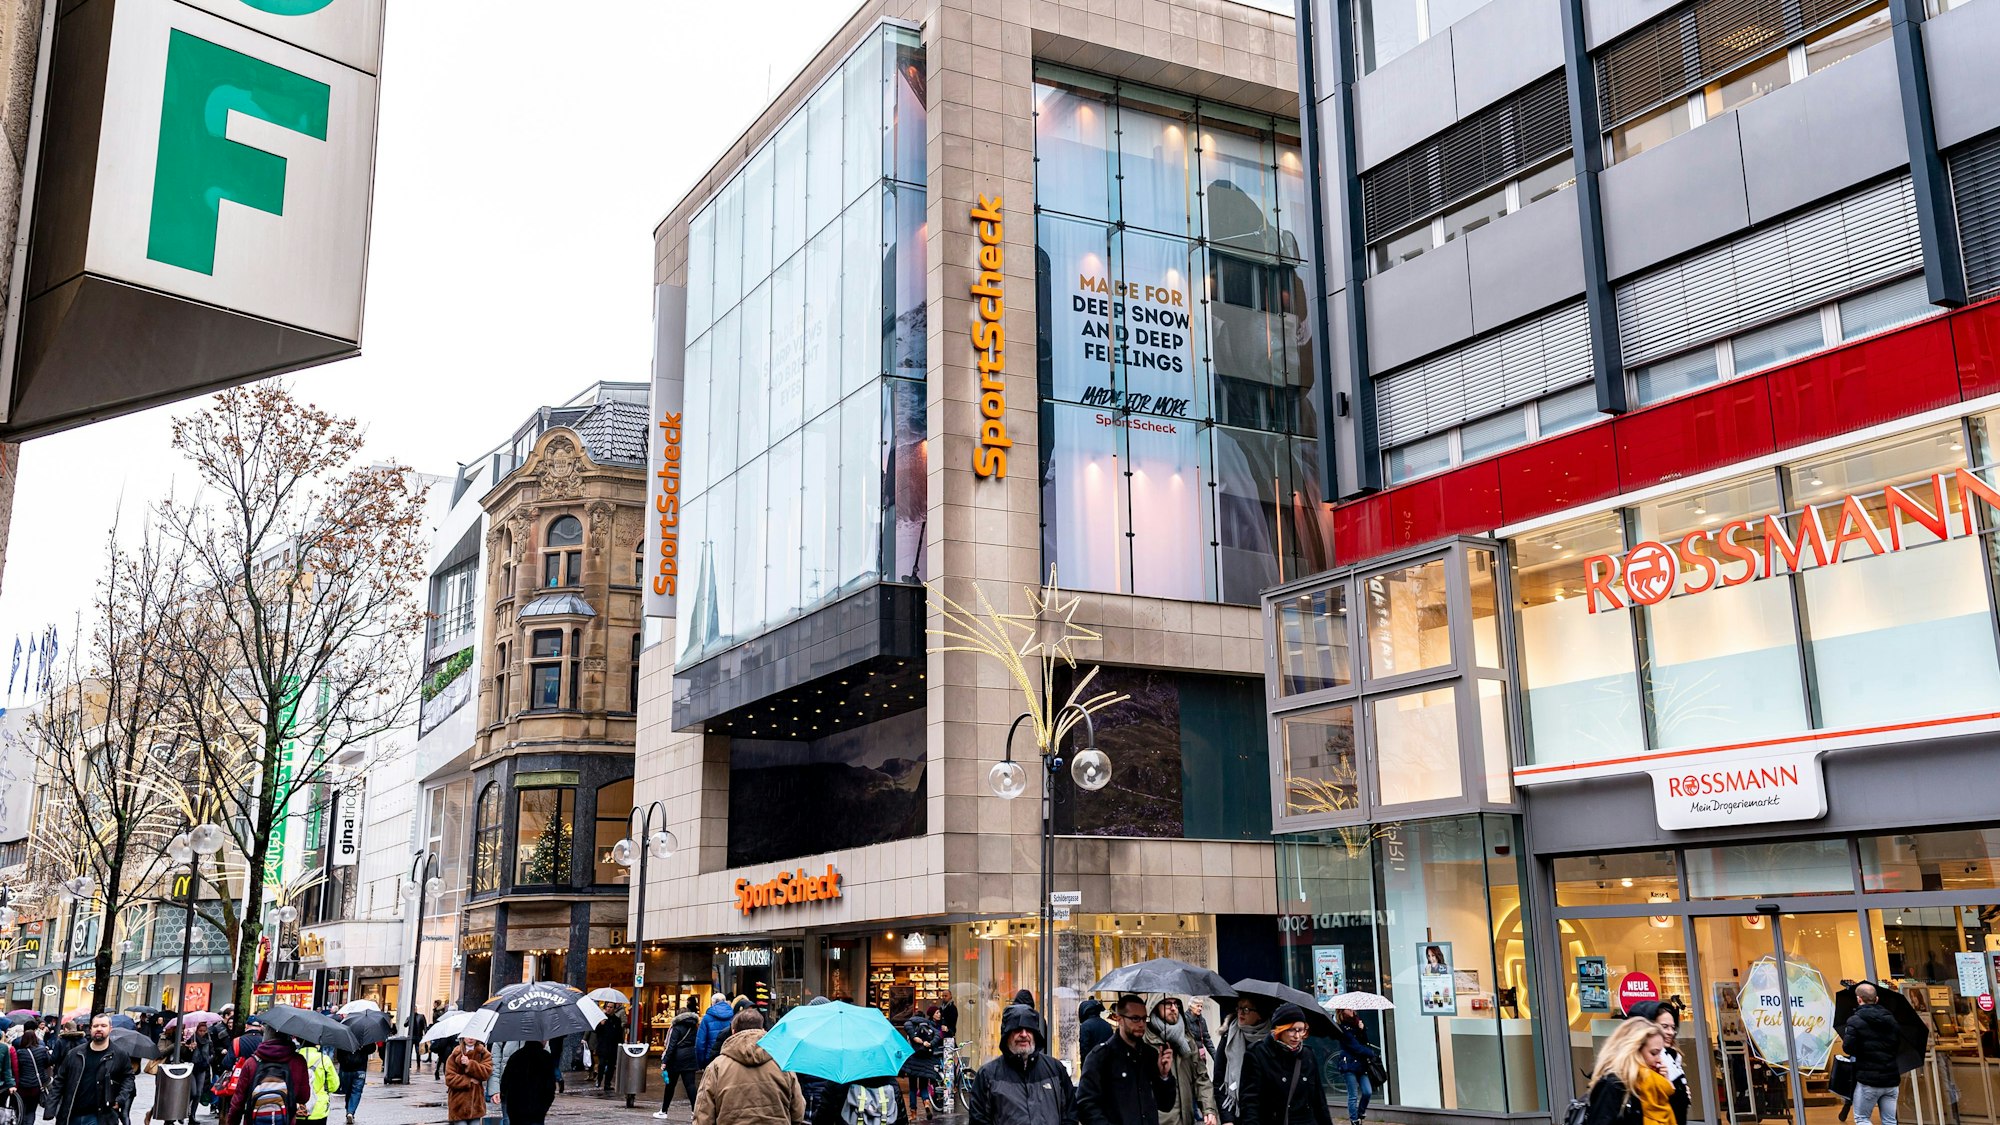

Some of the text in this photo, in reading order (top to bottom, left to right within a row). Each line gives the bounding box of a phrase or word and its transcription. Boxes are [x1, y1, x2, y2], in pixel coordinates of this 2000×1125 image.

[1079, 273, 1184, 307] MADE FOR
[1073, 295, 1190, 329] DEEP SNOW
[970, 192, 1012, 479] SportScheck
[1081, 320, 1184, 350] AND DEEP
[1084, 342, 1184, 373] FEELINGS
[1080, 385, 1191, 418] MADE FOR MORE
[1095, 413, 1177, 434] SportScheck
[653, 410, 682, 597] SportScheck
[1583, 467, 2000, 615] ROSSMANN
[1668, 764, 1798, 798] ROSSMANN
[1689, 794, 1781, 815] Mein Drogeriemarkt
[734, 864, 842, 916] SportScheck
[1053, 894, 1079, 904] Schildergasse
[507, 990, 568, 1011] Callaway
[1627, 980, 1650, 991] NEUE
[525, 1000, 550, 1008] GOLF
